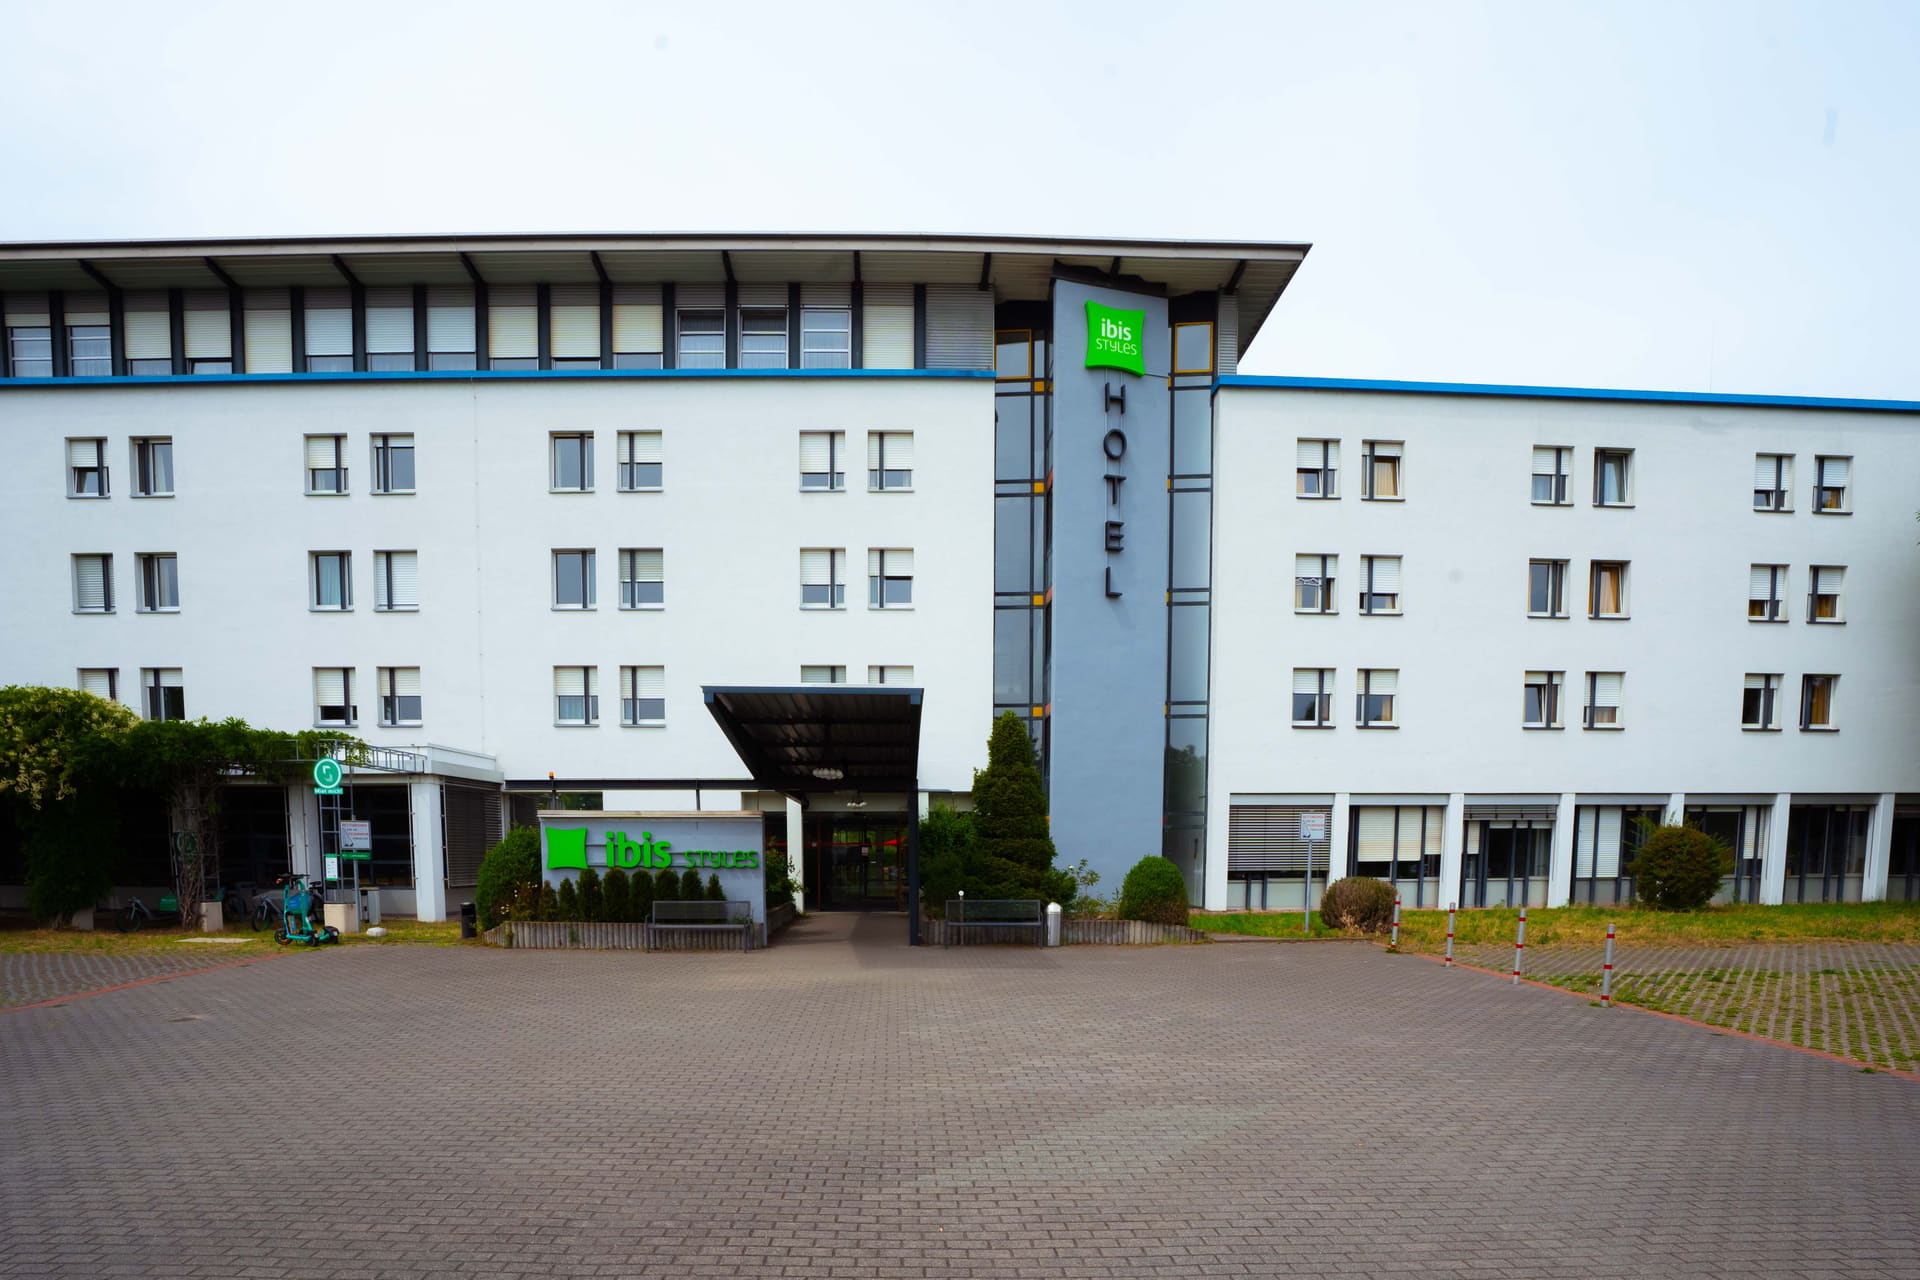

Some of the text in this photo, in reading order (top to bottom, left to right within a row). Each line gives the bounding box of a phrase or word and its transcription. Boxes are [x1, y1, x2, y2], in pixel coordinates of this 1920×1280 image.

[1101, 317, 1132, 341] ibis
[1103, 382, 1127, 598] HOTEL
[605, 831, 673, 869] ibis
